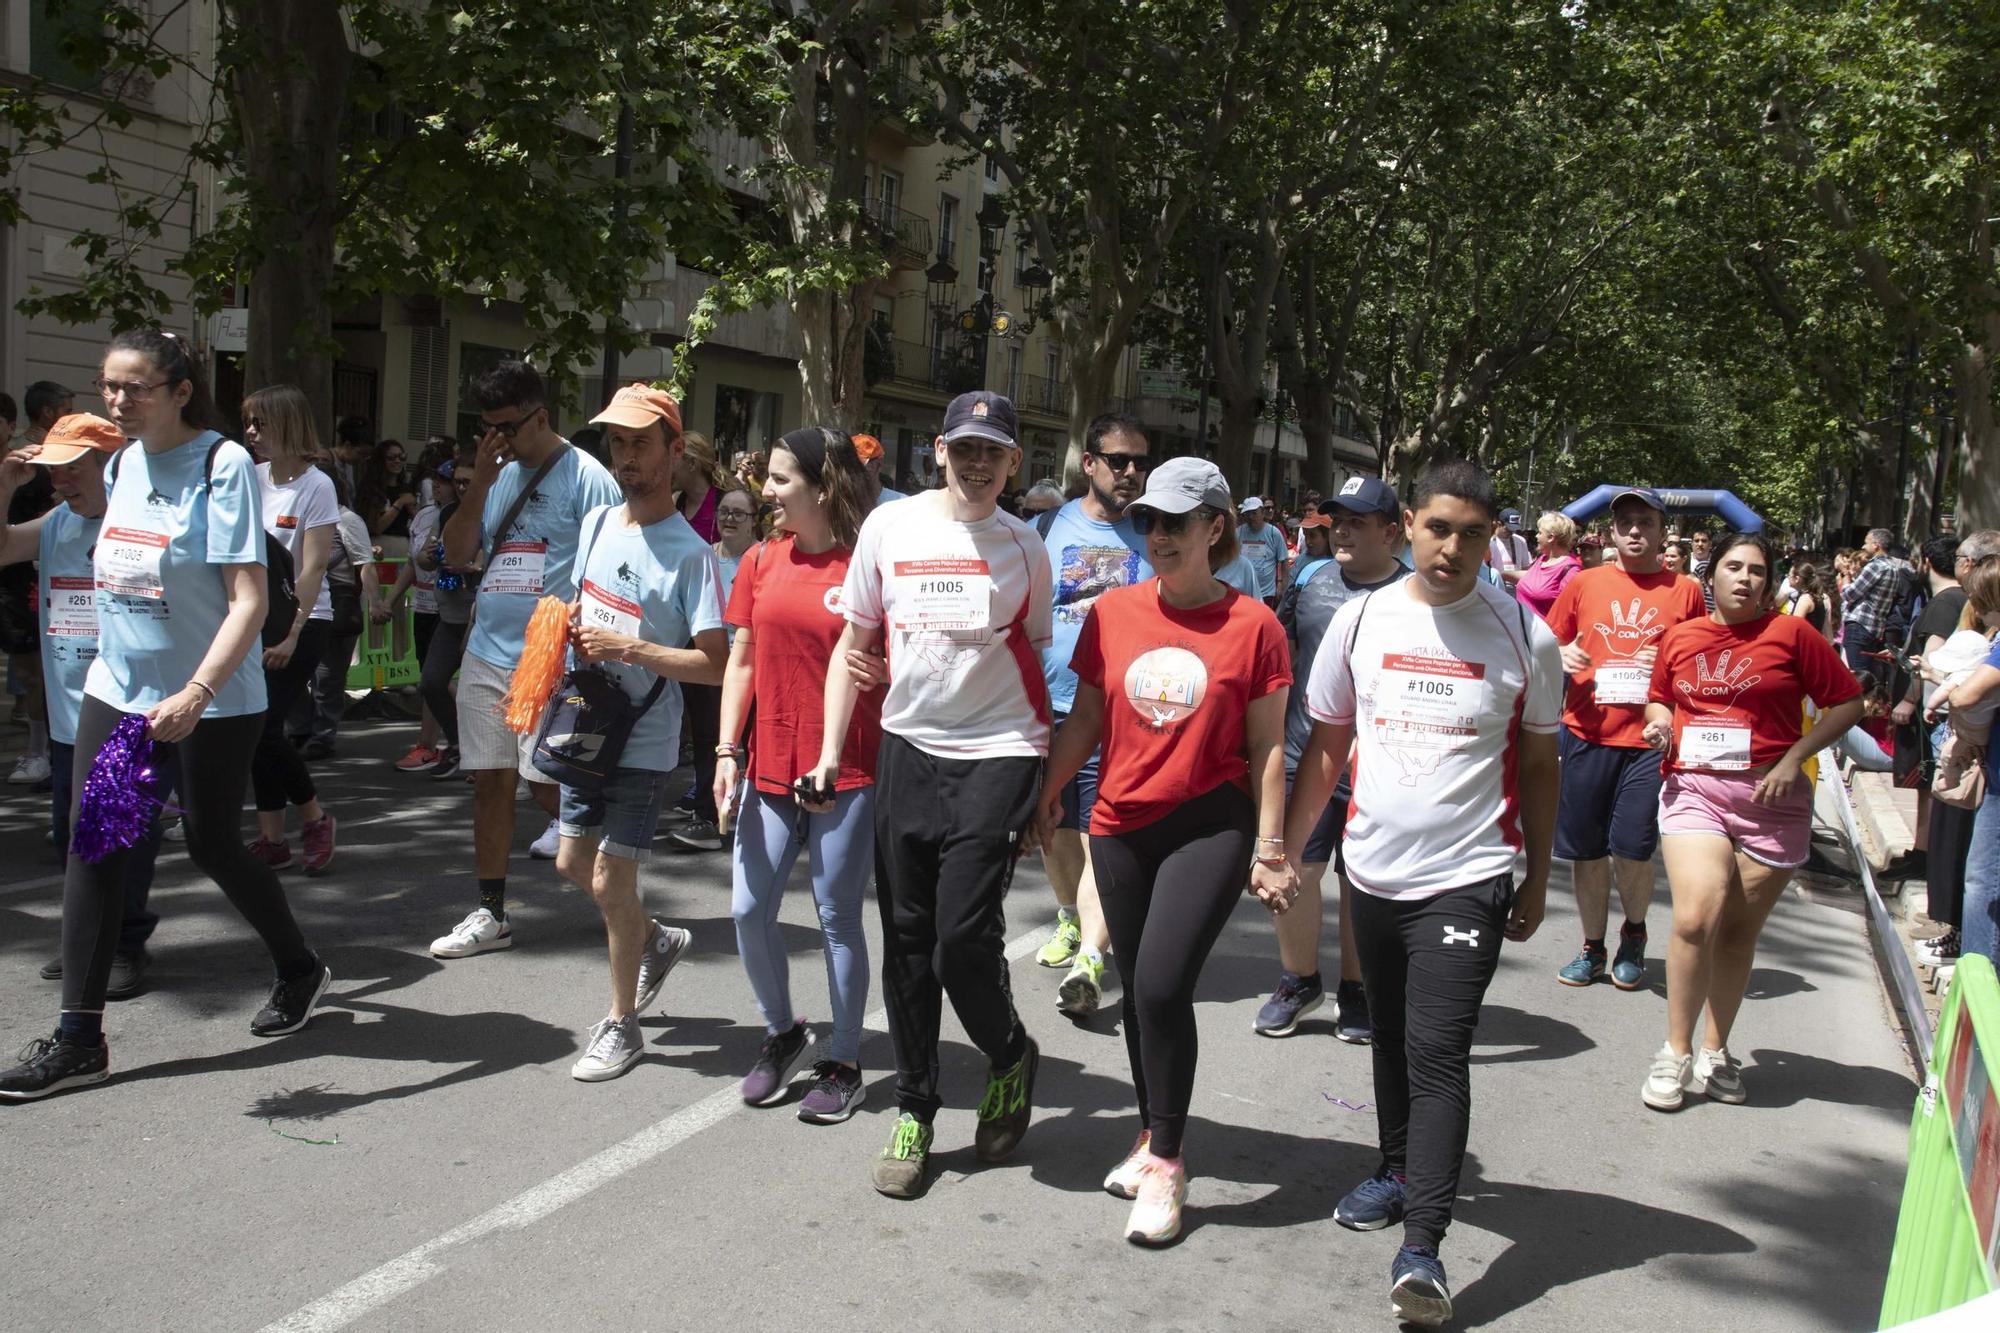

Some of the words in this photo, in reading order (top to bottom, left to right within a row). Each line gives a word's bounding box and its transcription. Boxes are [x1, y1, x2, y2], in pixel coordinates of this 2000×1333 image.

[502, 557, 522, 566] #261
[920, 581, 964, 593] #1005
[68, 595, 92, 605] #261
[594, 608, 616, 625] #261
[1618, 630, 1640, 639] COM
[1408, 680, 1454, 696] #1005
[1702, 686, 1729, 695] COM
[1385, 720, 1406, 729] SOM
[1407, 722, 1467, 735] DIVERSITAT
[1701, 732, 1725, 742] #261
